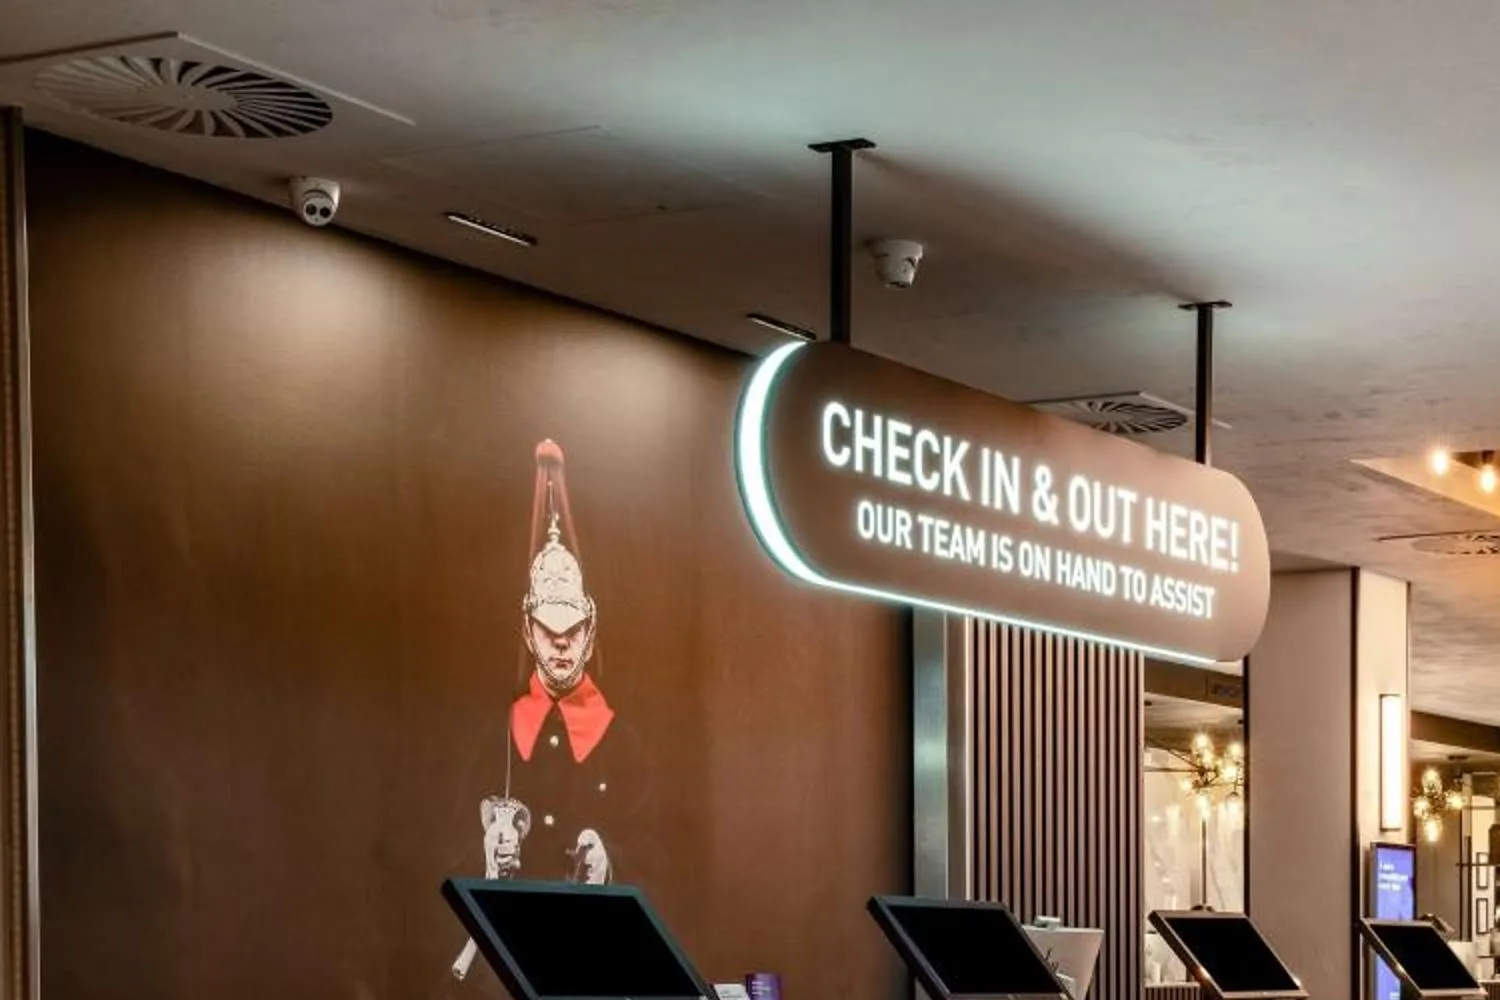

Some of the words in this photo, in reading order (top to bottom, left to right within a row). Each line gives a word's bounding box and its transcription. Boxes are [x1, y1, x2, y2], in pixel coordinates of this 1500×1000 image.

[822, 401, 971, 501] CHECK
[980, 447, 1021, 515] IN
[1031, 464, 1060, 526] &
[1067, 474, 1138, 544] OUT
[1144, 496, 1239, 573] HERE!
[856, 500, 913, 550] OUR
[916, 514, 986, 567] TEAM
[991, 533, 1015, 573] IS
[1017, 540, 1052, 582] ON
[1055, 549, 1118, 597] HAND
[1118, 564, 1148, 604] TO
[1148, 574, 1216, 619] ASSIST
